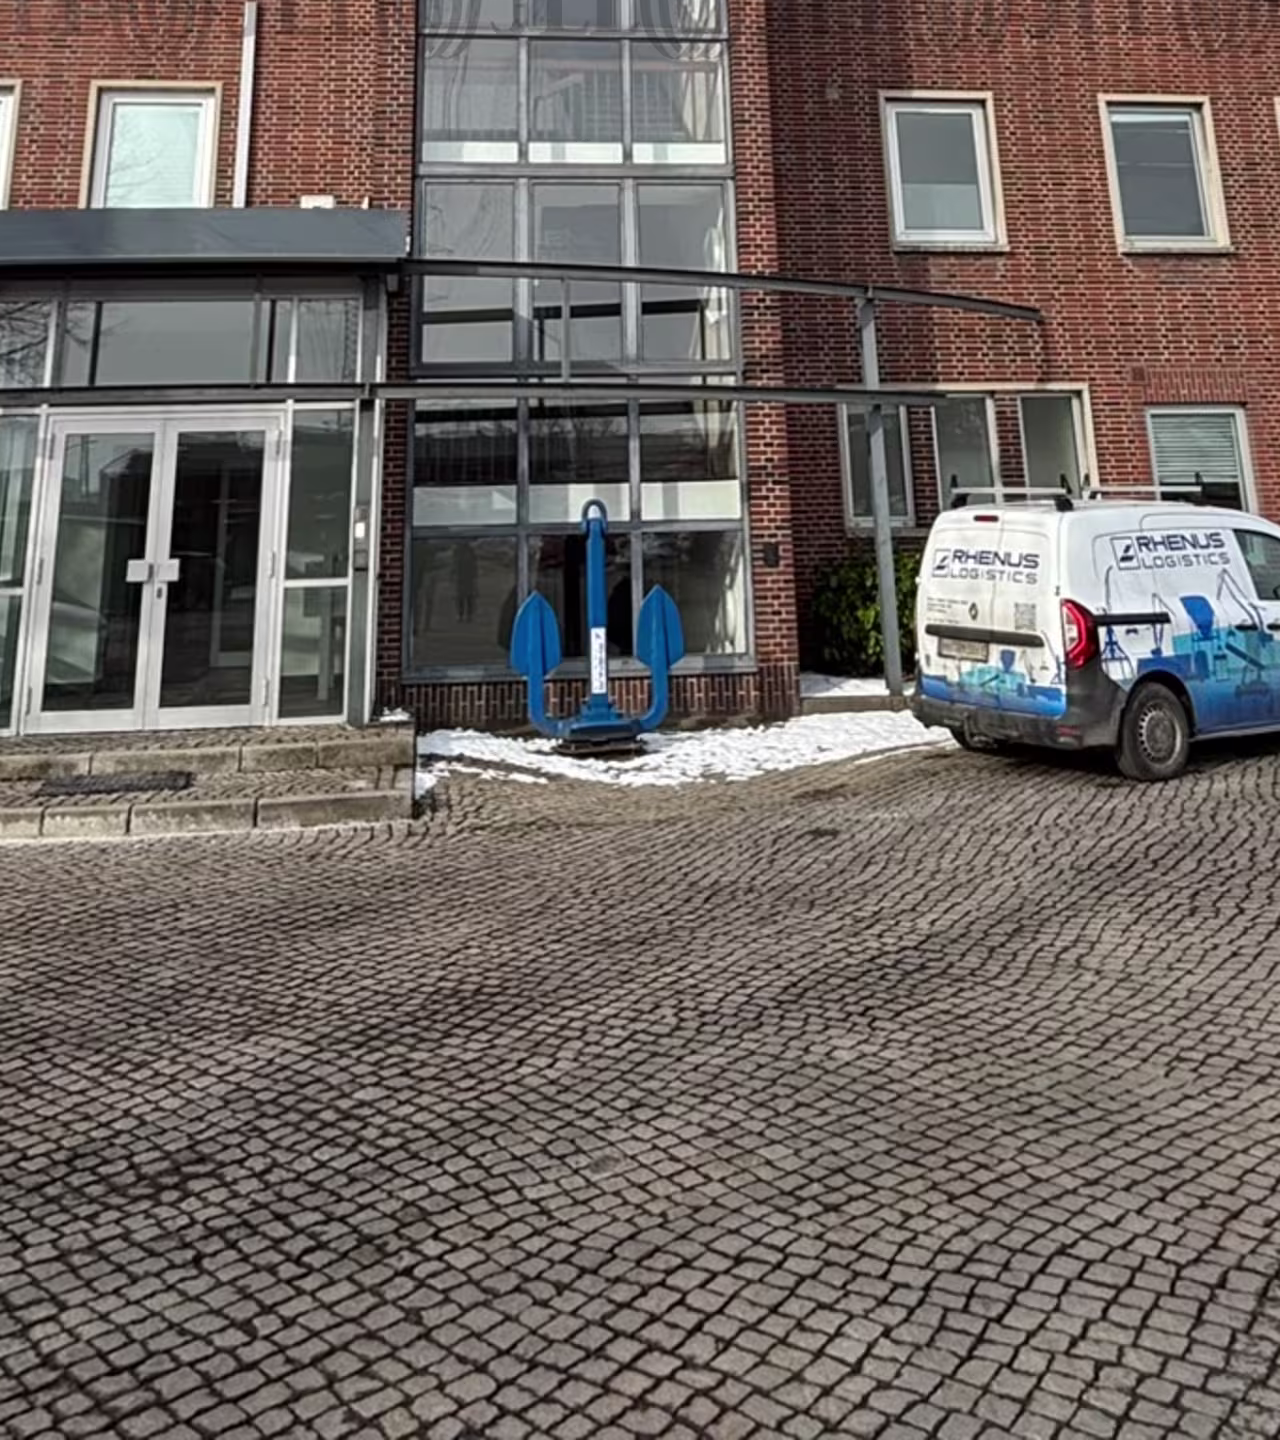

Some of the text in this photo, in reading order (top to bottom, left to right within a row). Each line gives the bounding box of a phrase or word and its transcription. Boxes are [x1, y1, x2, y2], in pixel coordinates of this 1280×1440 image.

[1135, 532, 1225, 552] RHENUS
[952, 549, 1040, 569] RHENUS
[1141, 552, 1231, 569] LOGISTICS
[950, 568, 1038, 585] LOGISTICS
